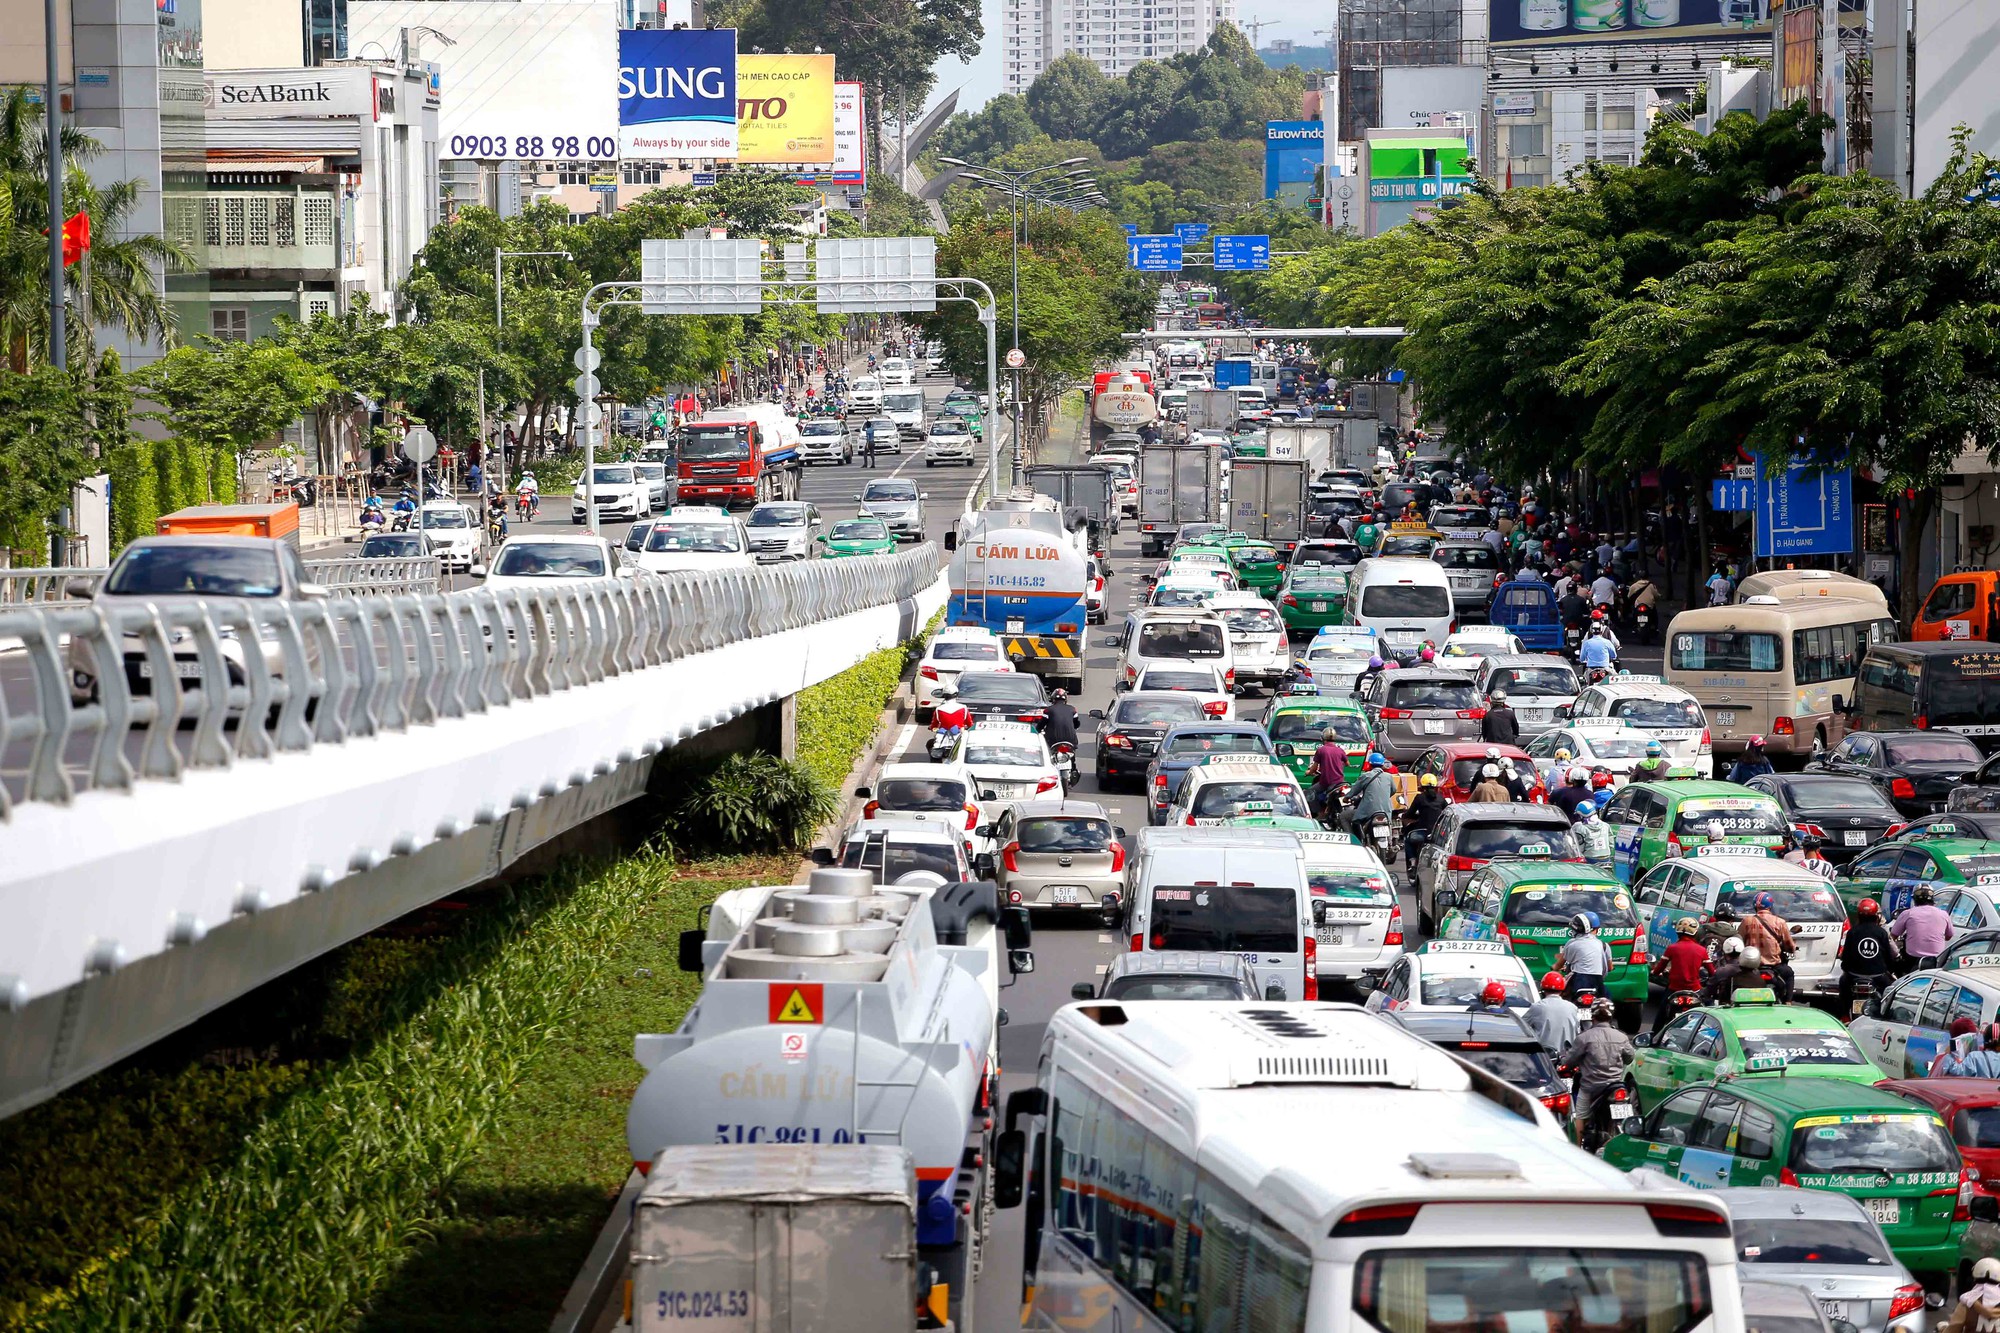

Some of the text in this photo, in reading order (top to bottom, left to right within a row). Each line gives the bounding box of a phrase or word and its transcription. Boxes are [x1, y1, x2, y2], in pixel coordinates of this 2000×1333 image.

[771, 72, 790, 81] CAO
[618, 67, 726, 99] SUNG
[221, 82, 331, 104] SeABank
[1268, 128, 1325, 139] Eurowindo
[451, 135, 616, 158] 0903 88 98 00
[633, 137, 669, 150] Always
[671, 137, 683, 150] by
[685, 140, 708, 150] your
[710, 137, 731, 149] side
[1405, 184, 1417, 196] OK
[1275, 446, 1292, 455] 54Y
[1831, 479, 1840, 495] LONG
[1796, 538, 1813, 547] GIANG
[976, 541, 1060, 560] CẤM LỬA
[988, 575, 1046, 587] 51C-445.82
[1678, 636, 1693, 651] 03
[1722, 818, 1766, 830] 28 28 28
[1325, 833, 1335, 842] 27
[1445, 941, 1472, 950] 38.27
[1789, 1048, 1808, 1057] 28
[1808, 1048, 1828, 1057] 28
[1831, 1049, 1848, 1058] 28
[1757, 1057, 1782, 1068] TAXI
[1801, 1176, 1826, 1186] TAXI
[1907, 1172, 1920, 1185] 38
[1921, 1172, 1933, 1184] 38
[1934, 1172, 1946, 1184] 38
[1947, 1171, 1959, 1183] 38
[1872, 1199, 1890, 1211] 51F
[658, 1290, 748, 1319] 51C.024.53
